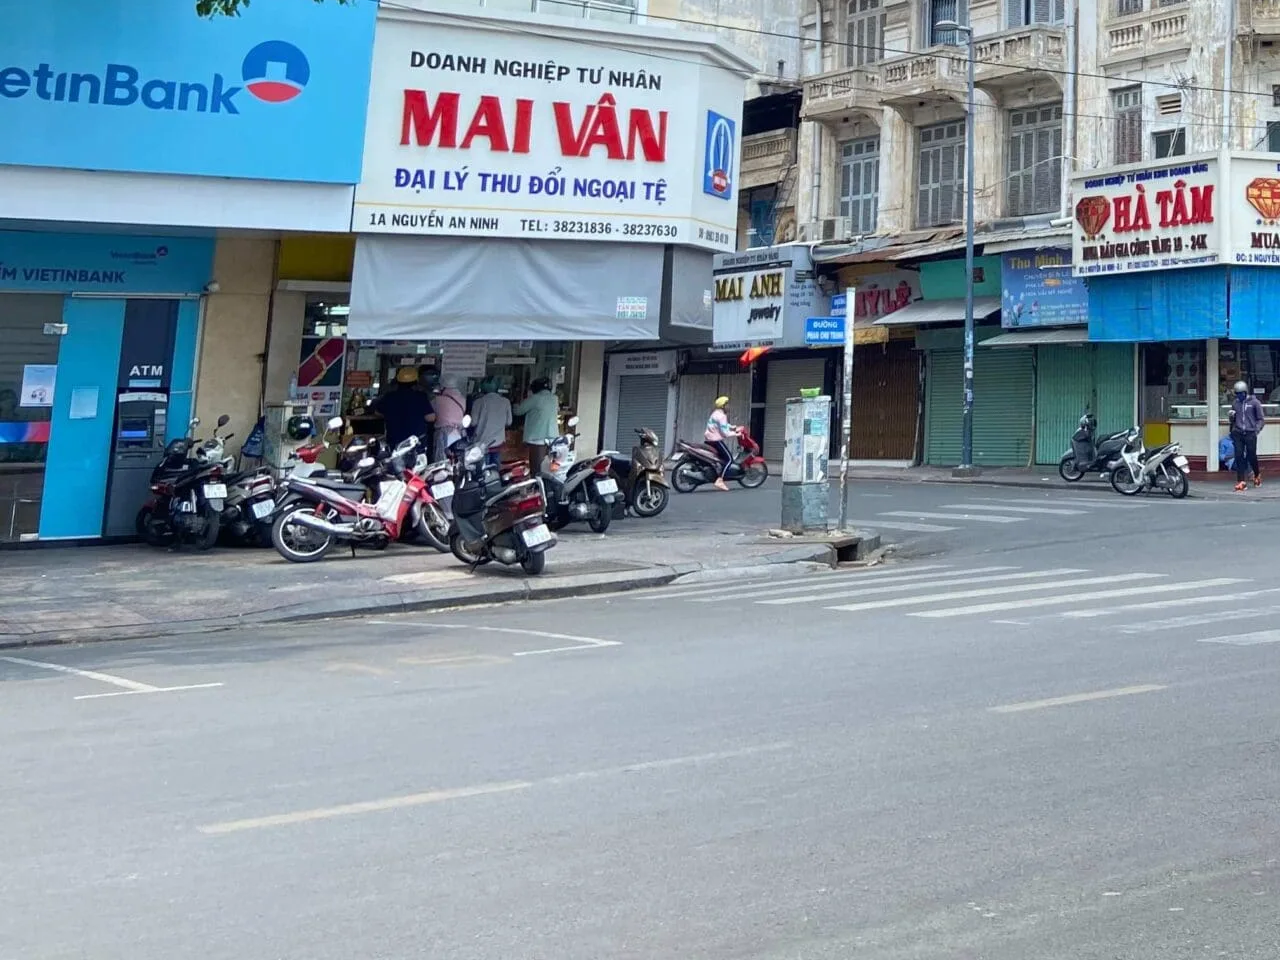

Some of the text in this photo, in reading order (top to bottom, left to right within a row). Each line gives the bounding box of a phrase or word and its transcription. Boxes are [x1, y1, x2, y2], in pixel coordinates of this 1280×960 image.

[411, 51, 662, 91] DOANH NGHIỆP TƯ NHÂN
[400, 89, 668, 162] MAI VÂN
[395, 166, 668, 205] ĐẠI LÝ THU ĐỔI NGOẠI TỆ
[1113, 179, 1214, 233] HÀ TÂM
[369, 213, 386, 227] 1A
[392, 210, 444, 228] NGUYỄN
[449, 215, 466, 229] AN
[470, 216, 499, 230] NINH
[520, 219, 549, 233] TEL:
[553, 221, 612, 235] 38231836
[622, 223, 678, 238] 38237630
[1082, 246, 1098, 261] MUA
[1100, 241, 1115, 259] BÁN
[1191, 234, 1208, 250] 24K
[23, 268, 126, 284] VIETINBANK
[715, 276, 744, 303] MAI
[749, 272, 782, 299] ANH
[813, 320, 838, 329] ĐƯỜNG
[129, 364, 163, 377] ATM
